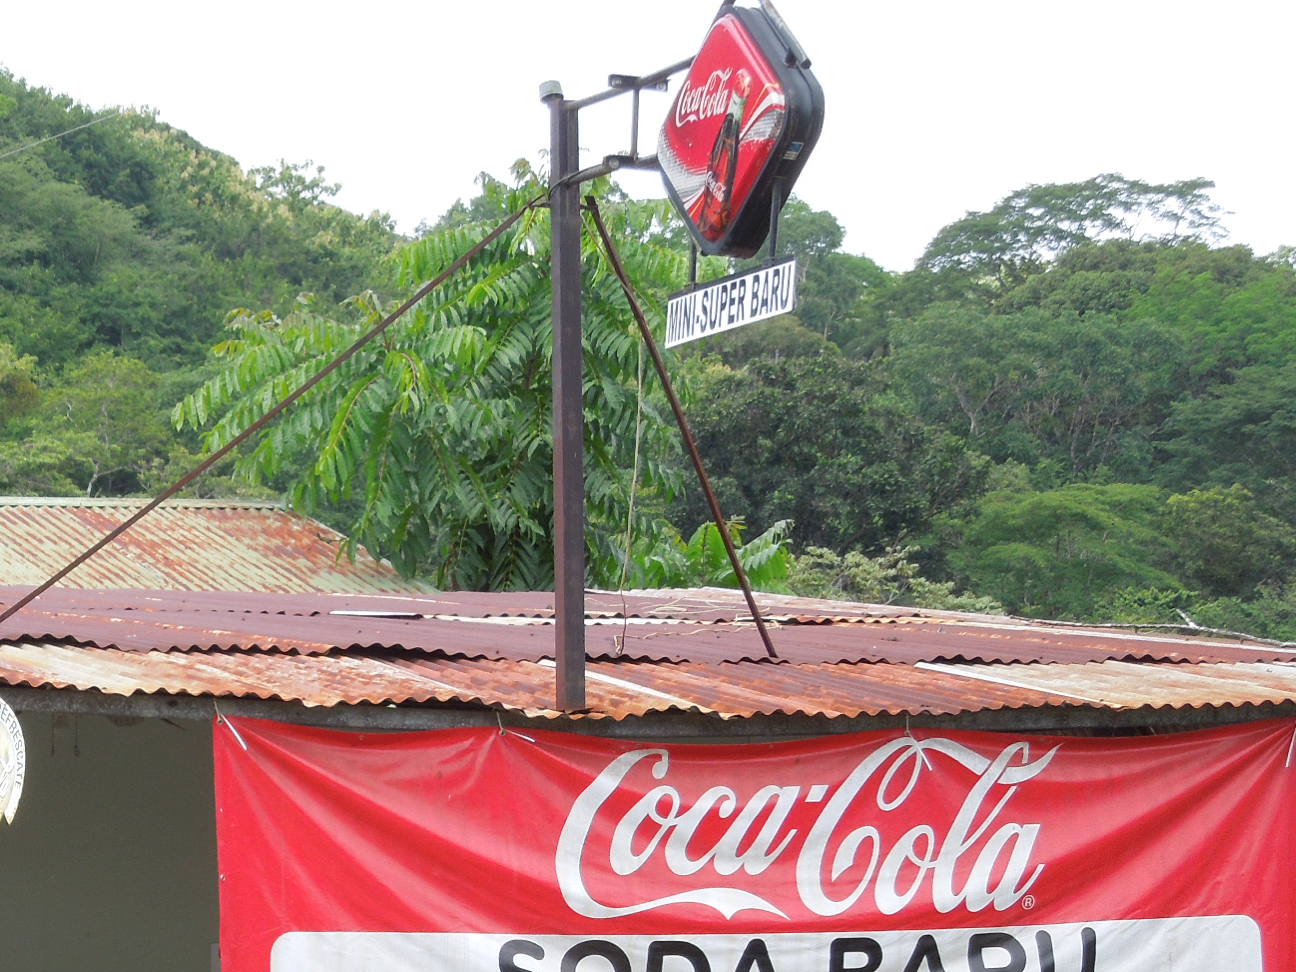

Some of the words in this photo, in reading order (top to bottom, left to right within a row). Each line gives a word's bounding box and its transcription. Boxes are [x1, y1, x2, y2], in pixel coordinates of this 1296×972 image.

[675, 67, 733, 128] Coca-Cola
[668, 278, 746, 344] MINI-SUPER
[750, 264, 792, 318] BARU
[555, 737, 1063, 920] Coca-Cola
